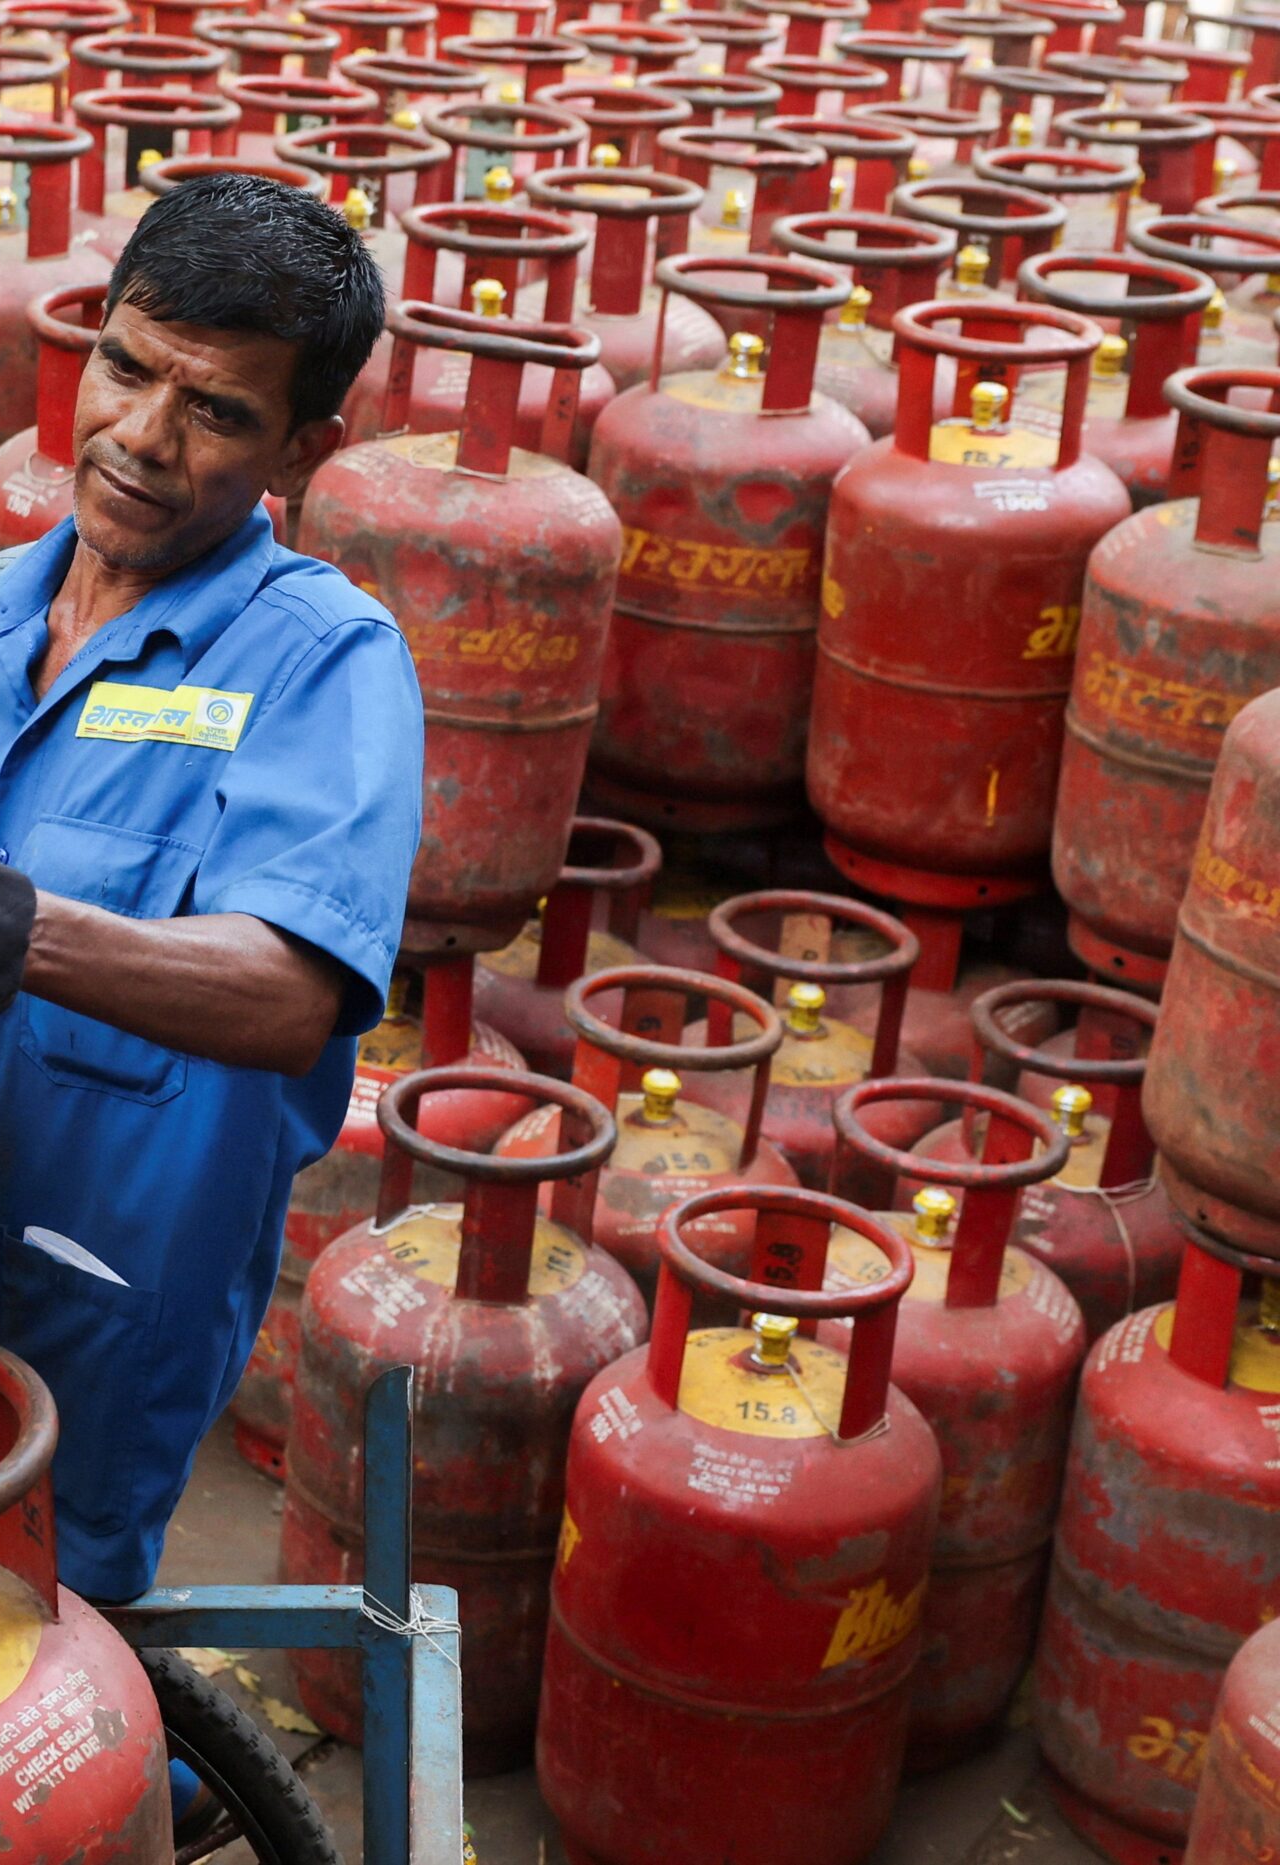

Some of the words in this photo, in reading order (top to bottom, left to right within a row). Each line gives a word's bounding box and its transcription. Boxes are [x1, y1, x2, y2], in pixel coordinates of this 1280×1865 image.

[85, 705, 156, 728] भारत
[736, 1401, 798, 1424] 15.8
[43, 1710, 66, 1732] की
[13, 1743, 64, 1788] CHECK
[55, 1722, 91, 1753] SEAL
[62, 1749, 87, 1774] ON
